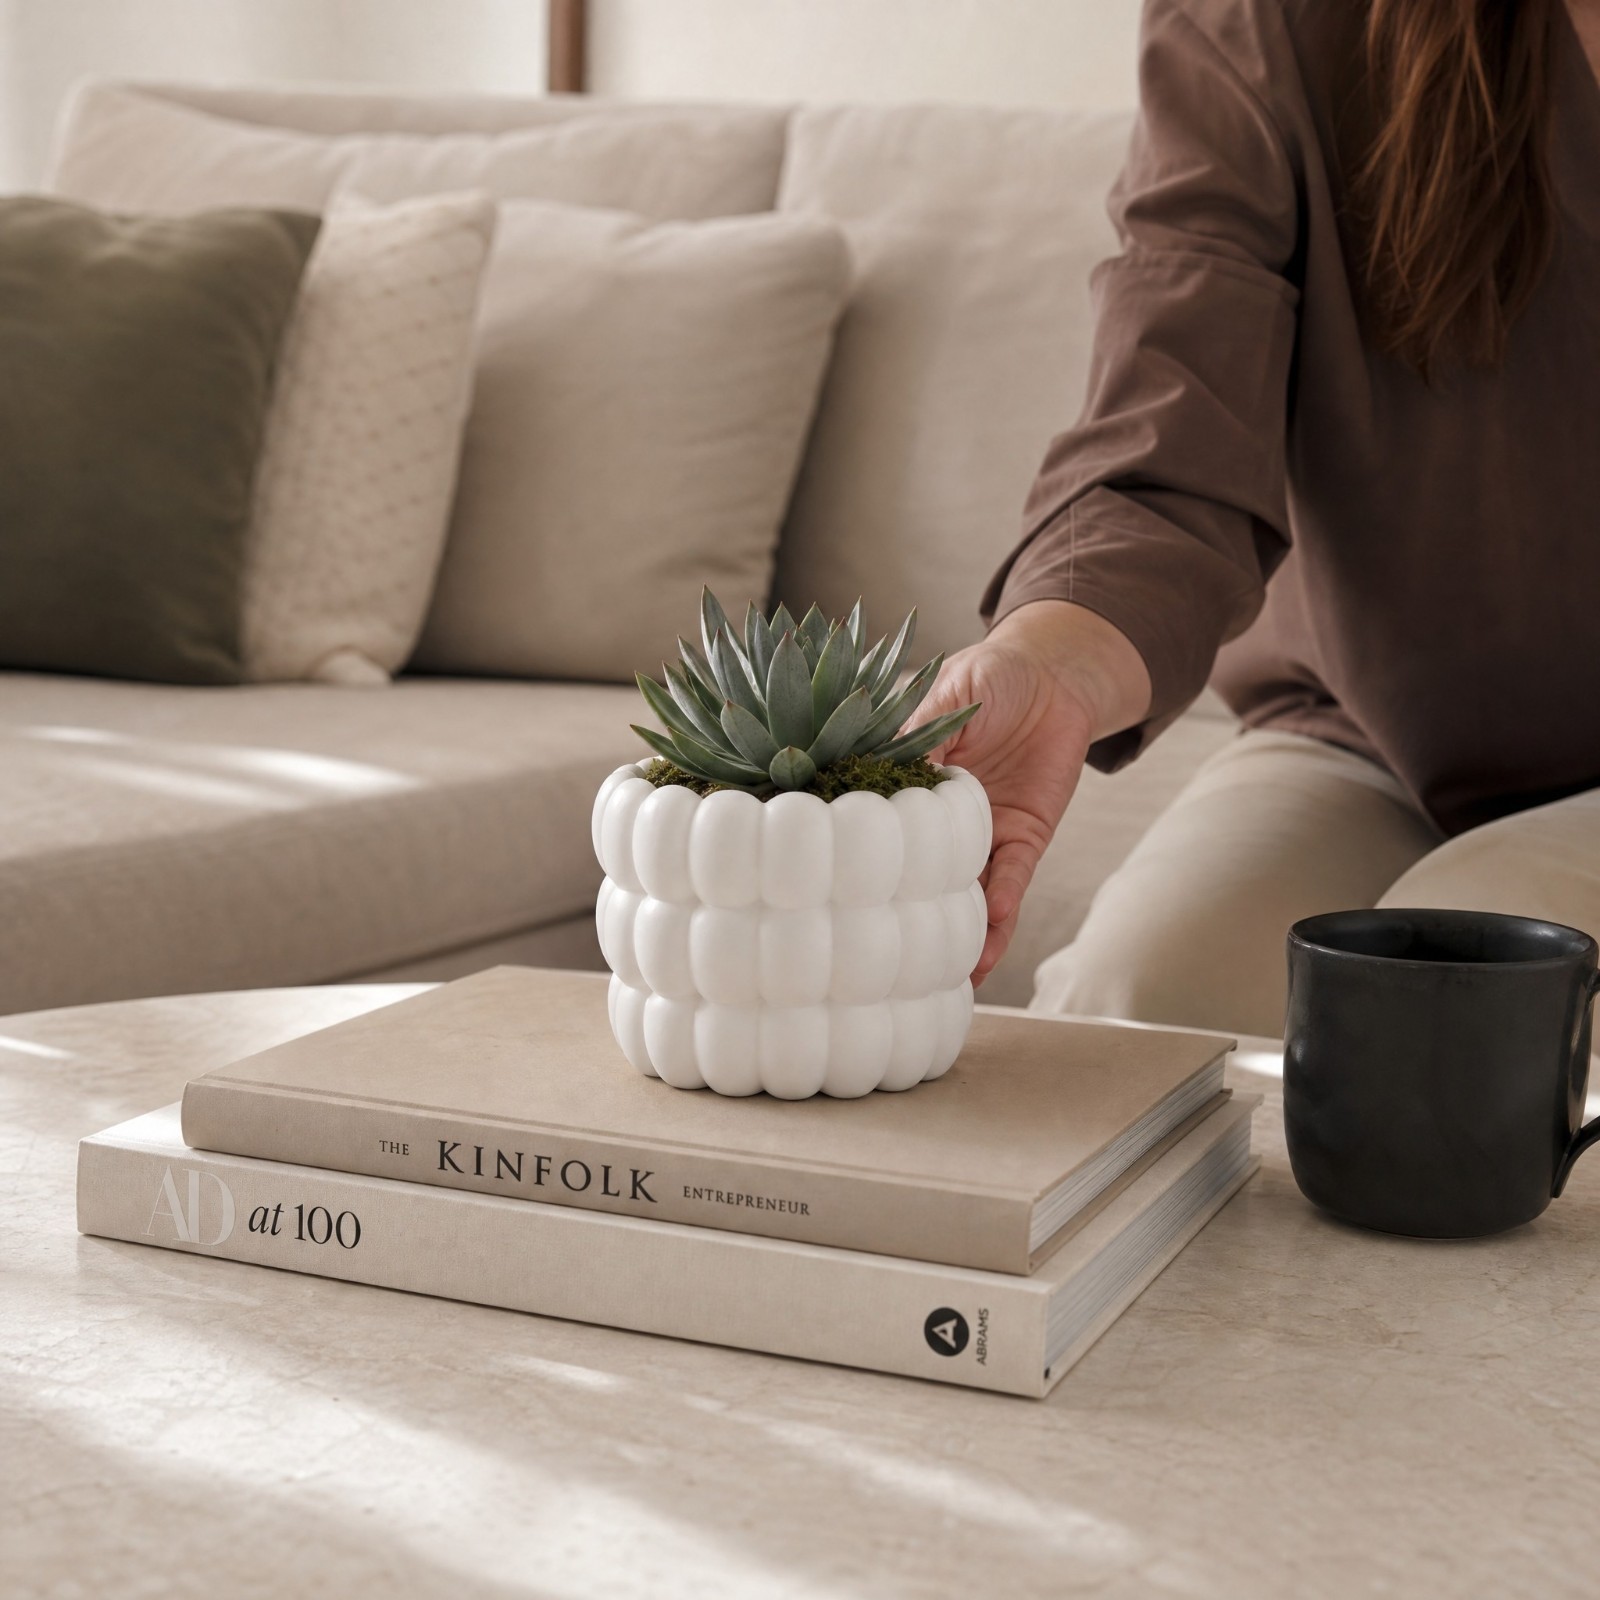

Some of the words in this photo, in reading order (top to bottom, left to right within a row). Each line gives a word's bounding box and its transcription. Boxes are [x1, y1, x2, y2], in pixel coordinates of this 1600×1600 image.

[144, 1165, 236, 1247] AD
[248, 1202, 283, 1237] at
[294, 1203, 361, 1249] 100
[379, 1140, 410, 1157] THE
[437, 1140, 658, 1203] KINFOLK
[683, 1186, 810, 1216] ENTREPRENEUR
[976, 1308, 989, 1366] ABRAMS
